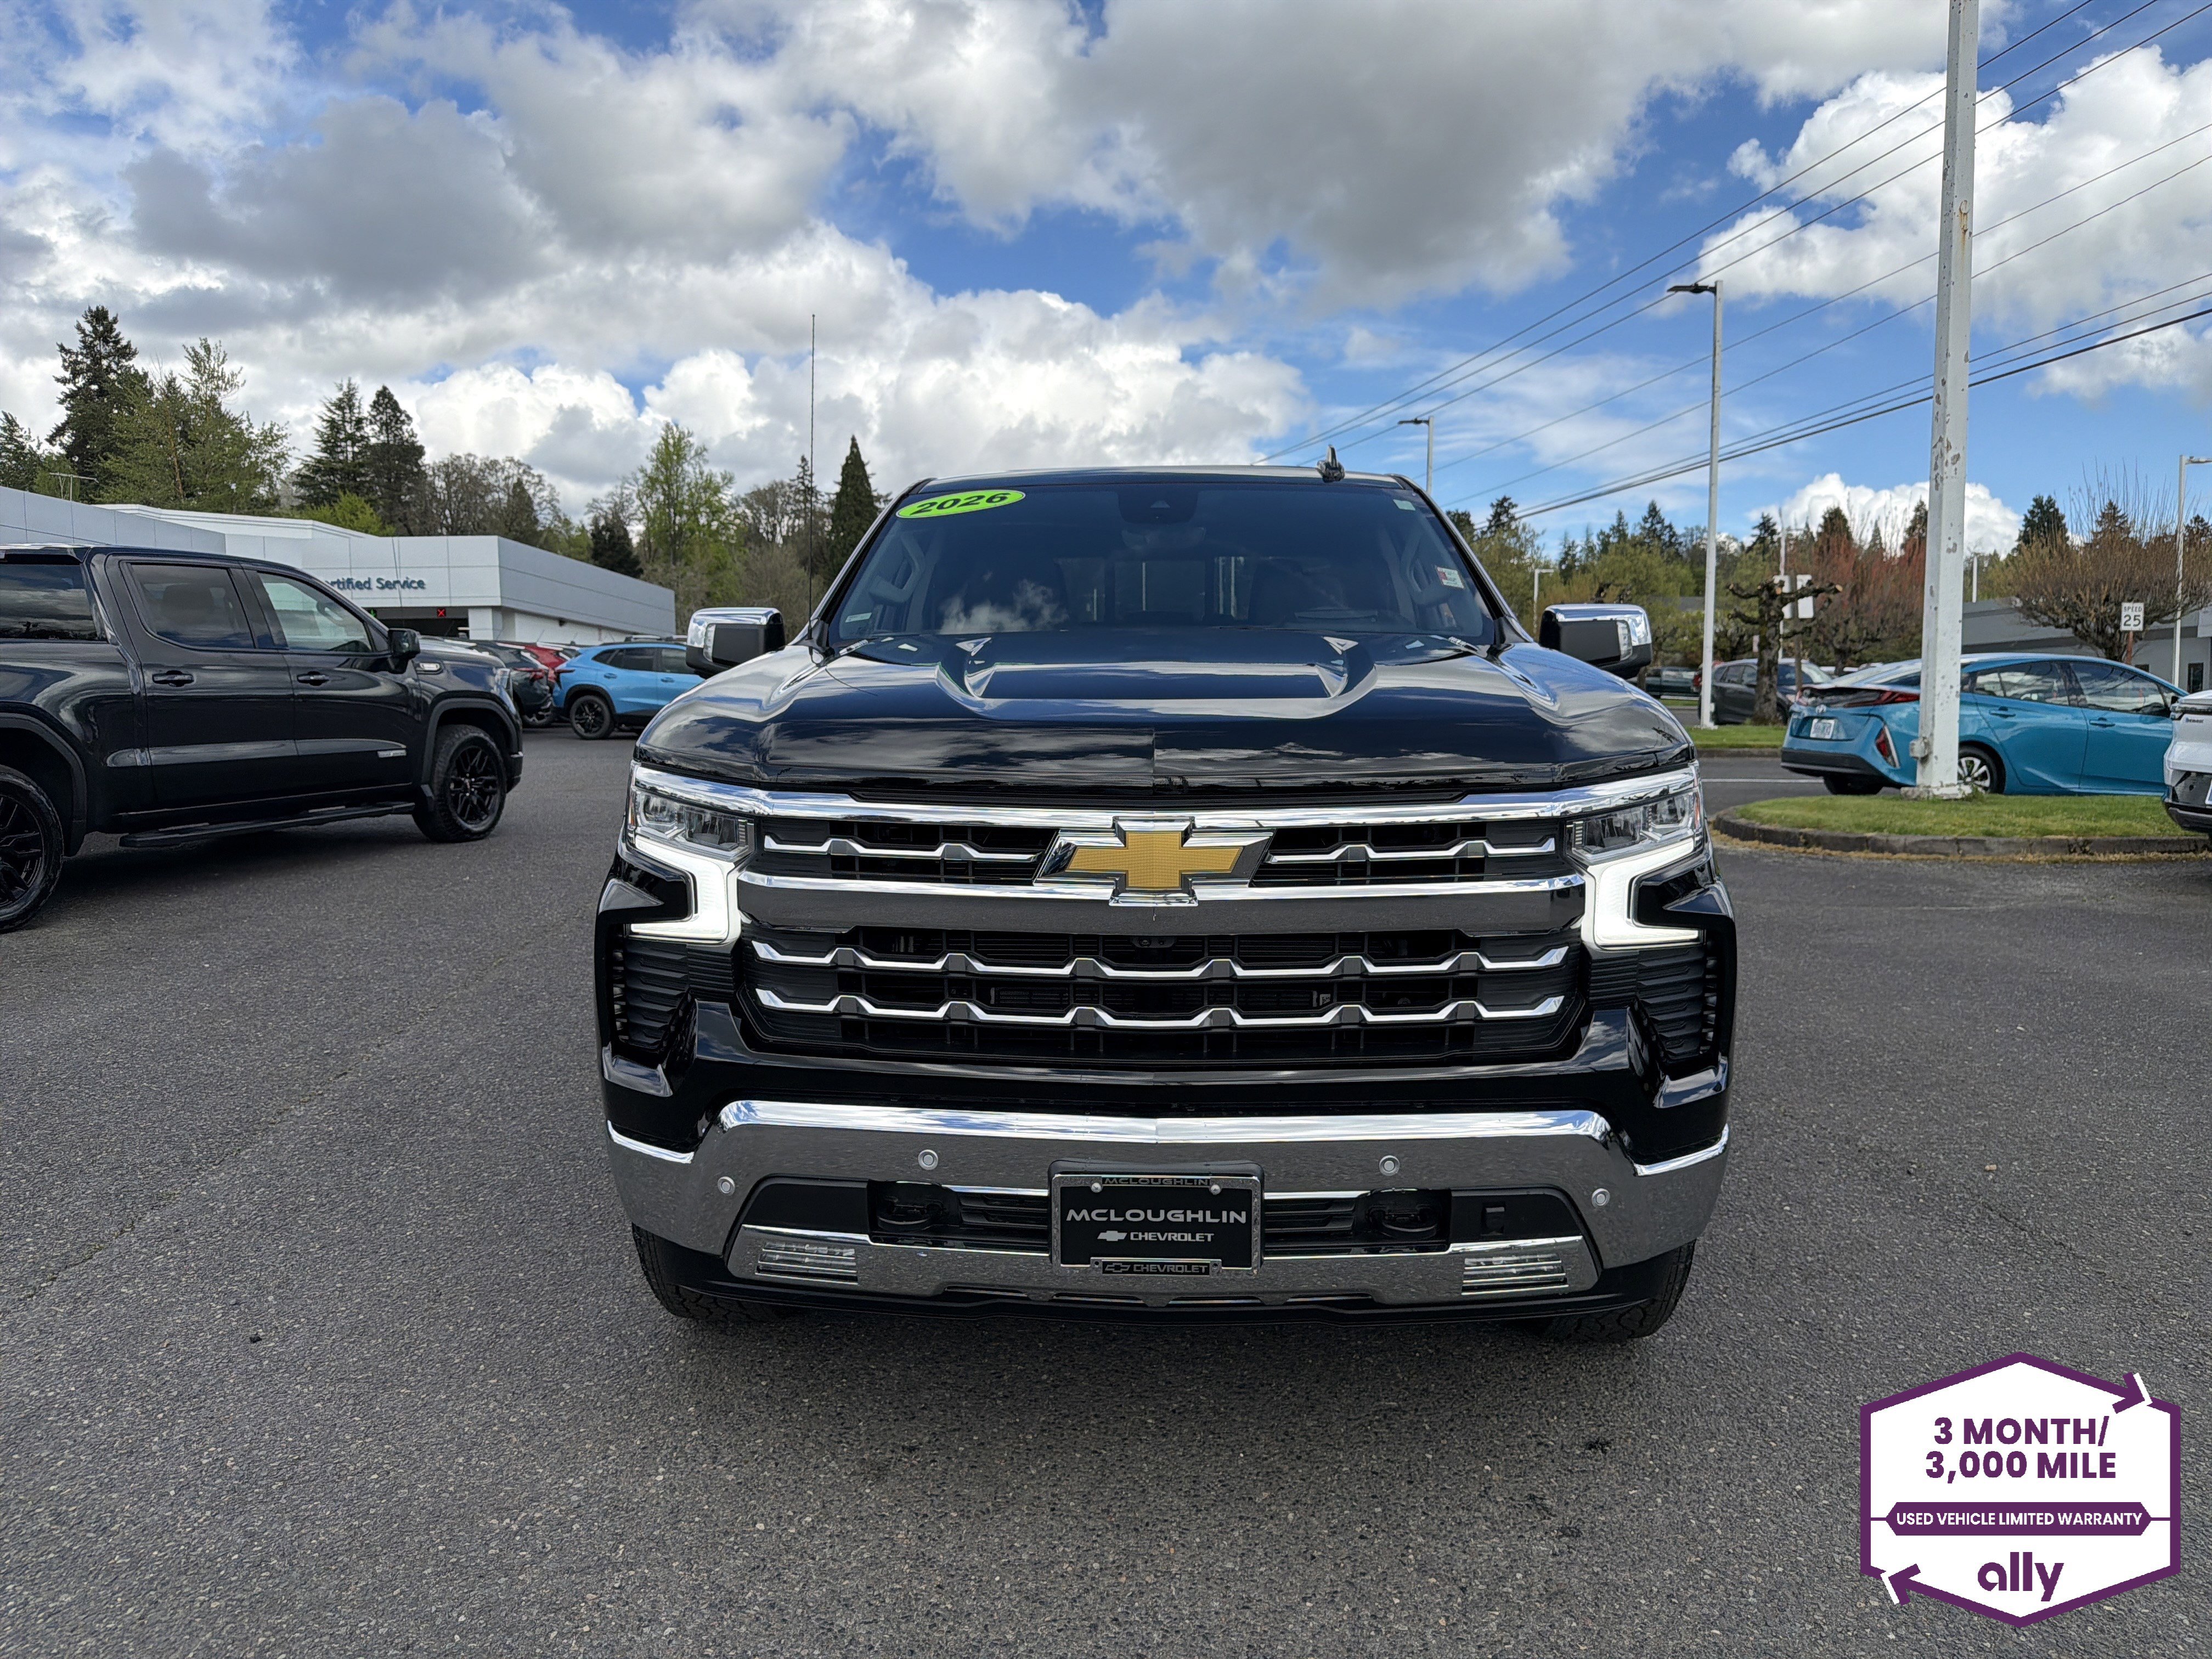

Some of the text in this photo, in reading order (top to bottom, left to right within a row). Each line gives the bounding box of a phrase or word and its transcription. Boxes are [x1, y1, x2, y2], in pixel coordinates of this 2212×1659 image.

[909, 493, 1011, 516] 2026
[325, 577, 426, 590] rtified Service
[2124, 614, 2141, 627] 25
[1066, 1209, 1246, 1223] MCLOUGHLIN
[1130, 1232, 1214, 1242] CHEVROLET
[1133, 1264, 1208, 1273] CHEVROLET
